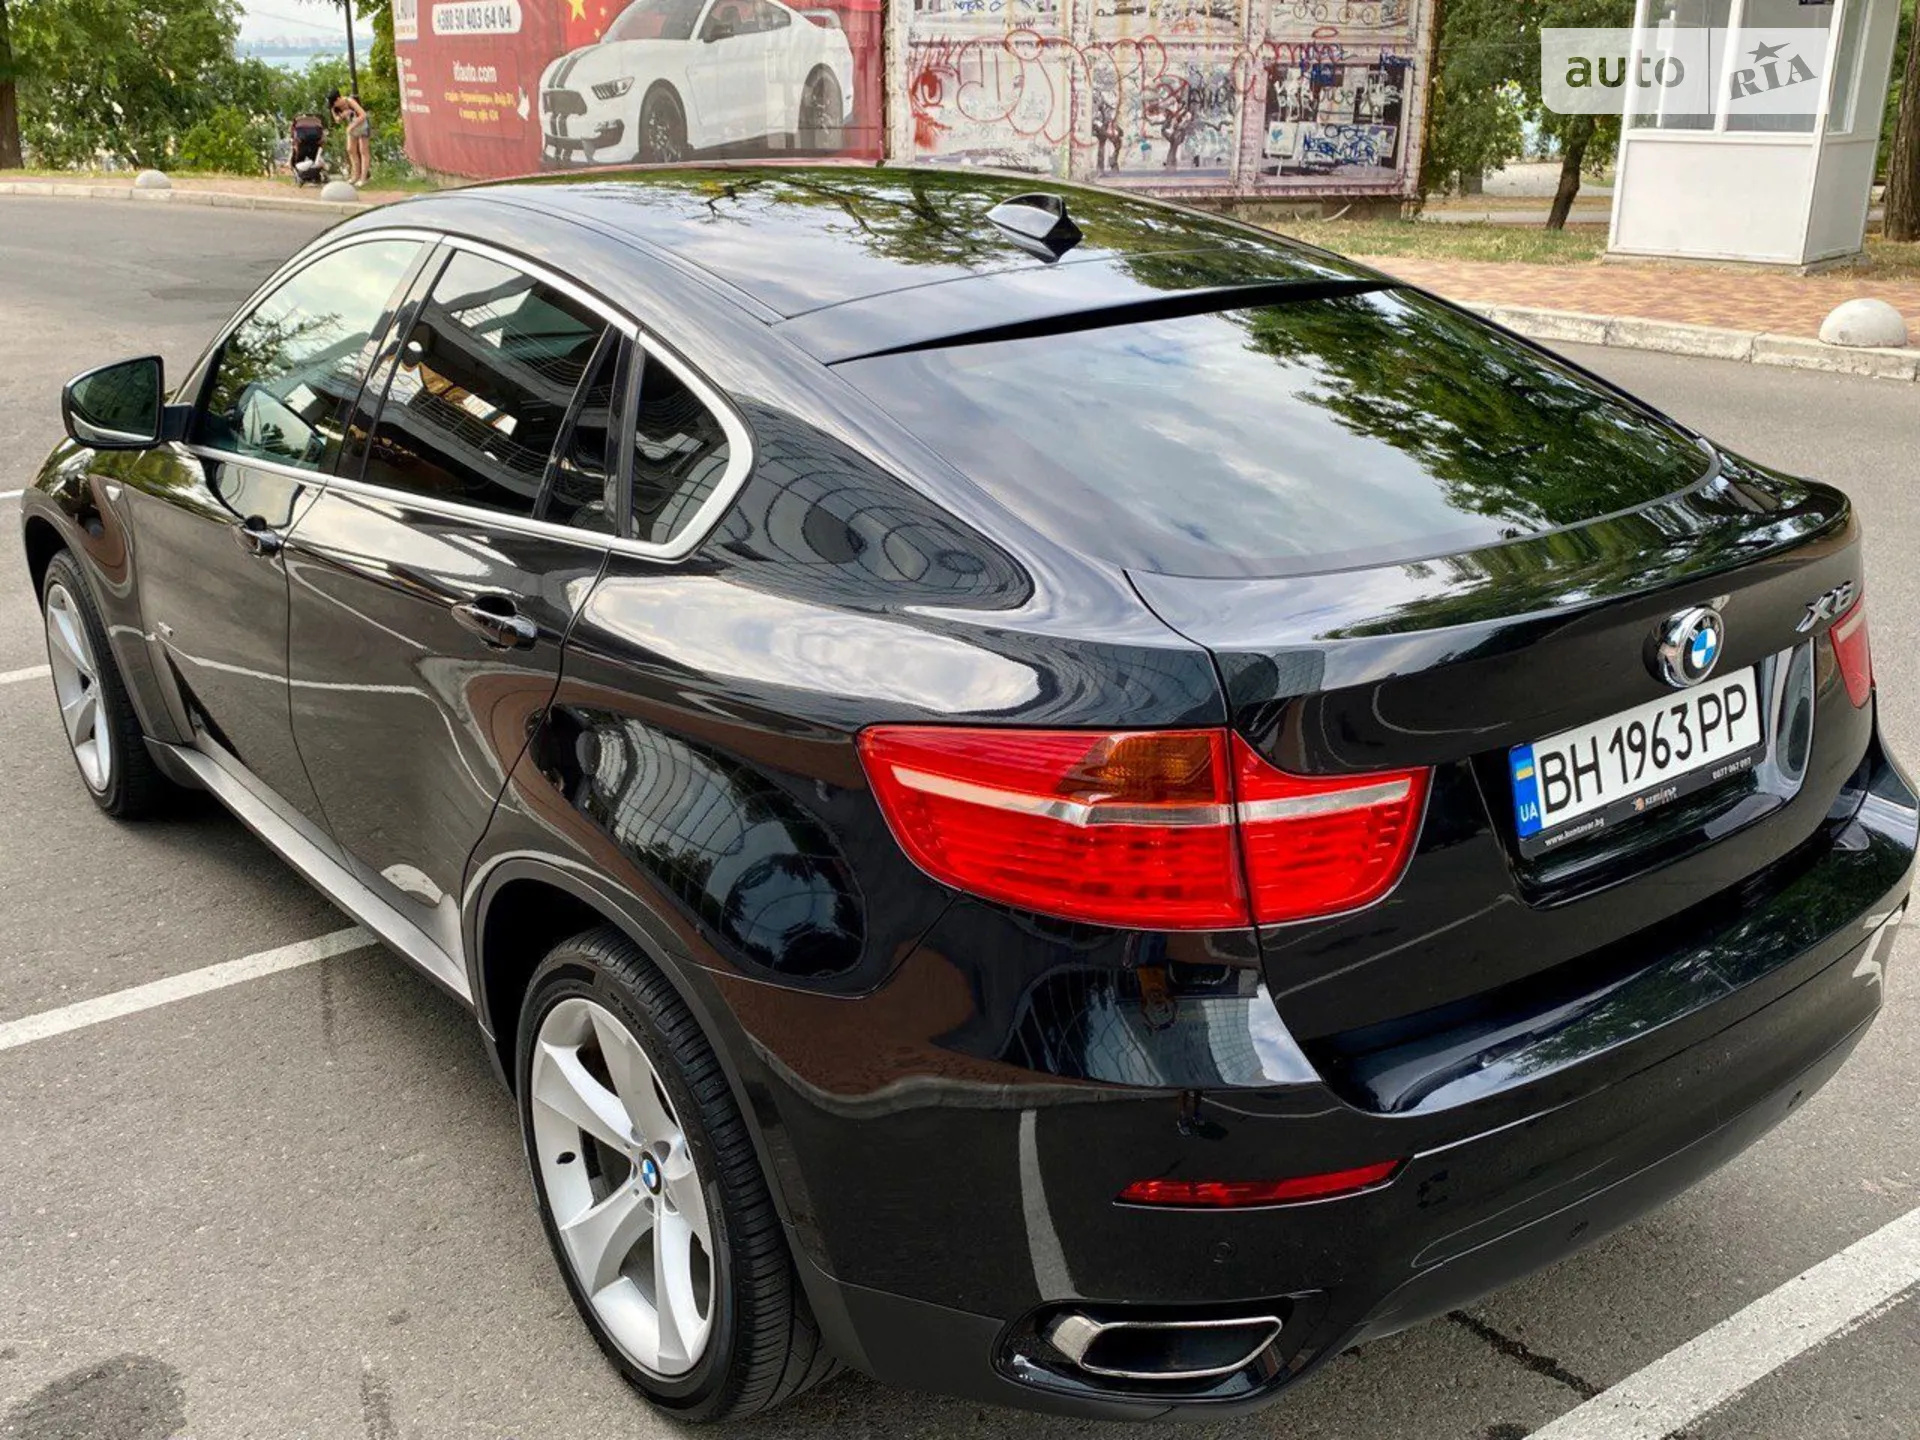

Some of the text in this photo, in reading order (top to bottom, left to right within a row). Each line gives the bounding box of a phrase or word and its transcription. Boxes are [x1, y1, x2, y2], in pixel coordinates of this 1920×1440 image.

[467, 8, 483, 29] 403
[499, 6, 512, 28] 04
[1538, 683, 1748, 816] BH 1963 PP
[1519, 800, 1539, 823] UA
